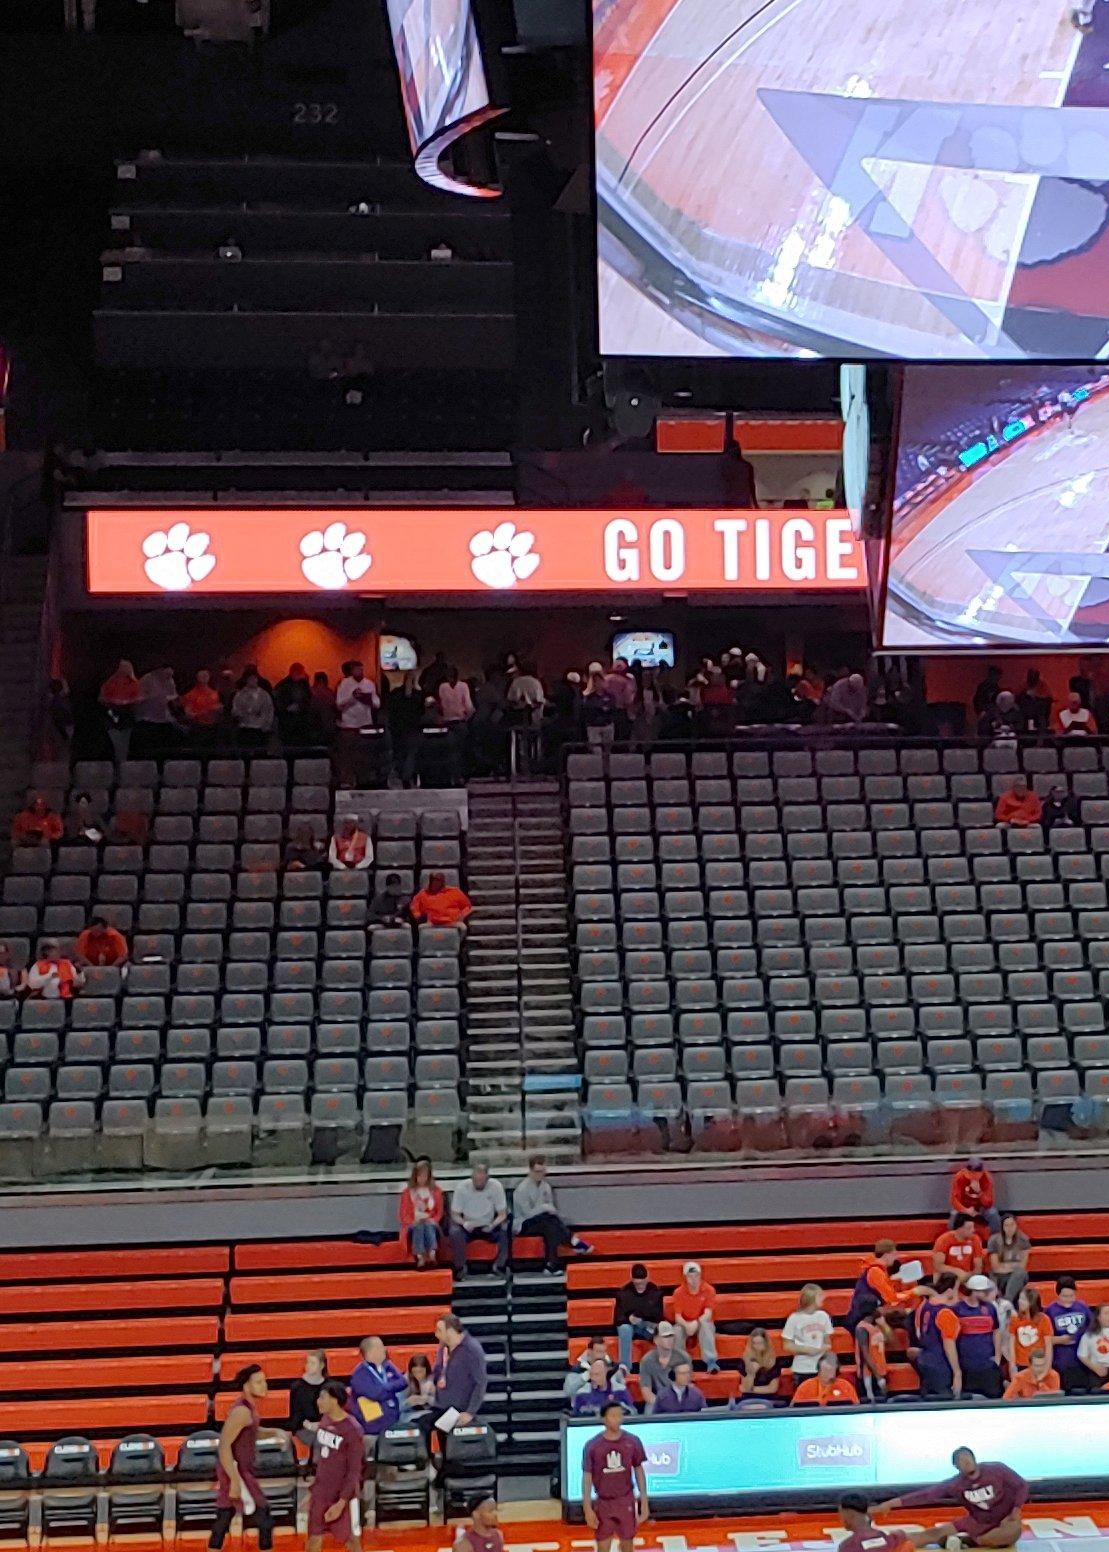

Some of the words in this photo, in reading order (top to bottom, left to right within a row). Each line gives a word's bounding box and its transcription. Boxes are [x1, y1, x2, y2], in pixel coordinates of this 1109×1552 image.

[293, 102, 338, 123] 232
[604, 518, 685, 582] GO
[713, 518, 858, 581] TIGE
[806, 1443, 863, 1460] StubHub
